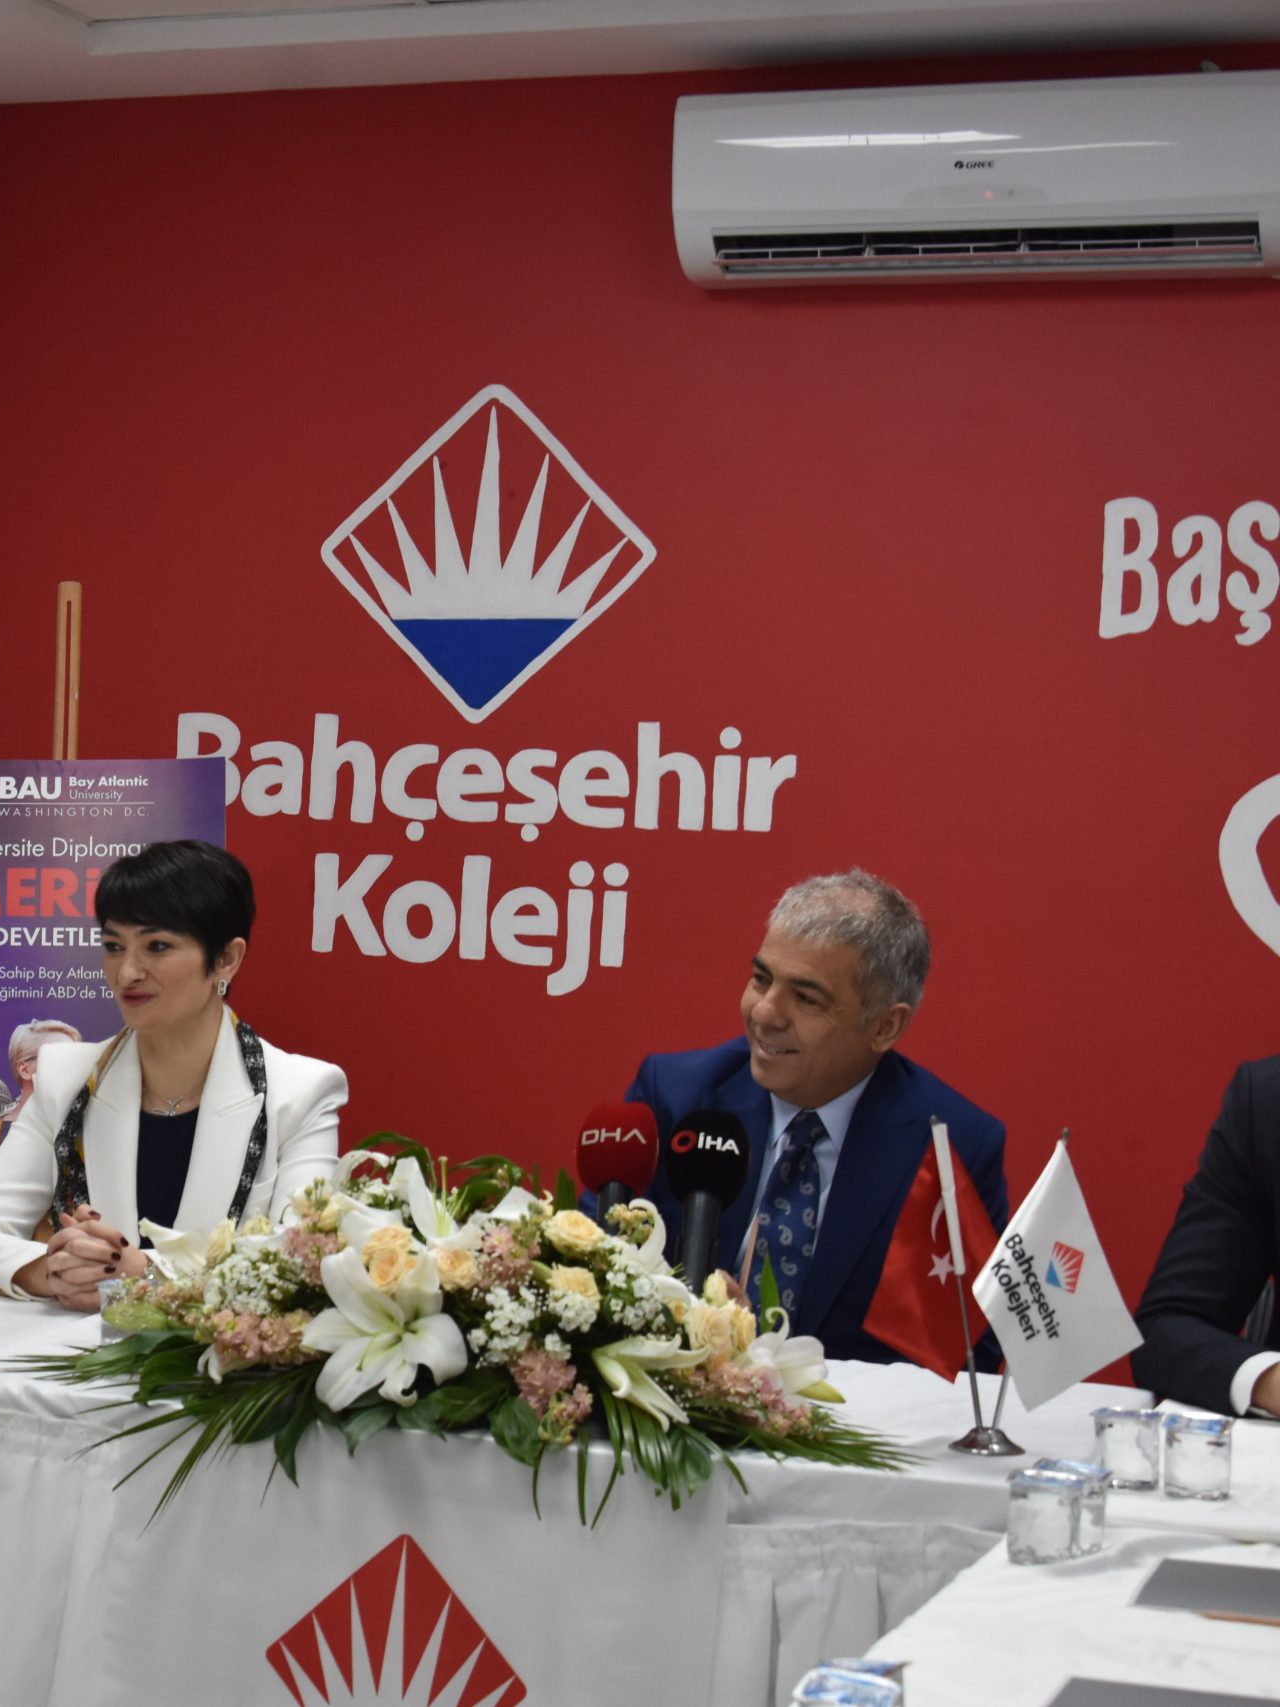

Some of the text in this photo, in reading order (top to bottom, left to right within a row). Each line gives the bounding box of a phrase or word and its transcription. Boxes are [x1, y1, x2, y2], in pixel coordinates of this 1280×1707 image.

[1098, 496, 1280, 646] Baş
[0, 776, 62, 800] BAU
[69, 775, 149, 791] Bay Atlantic
[176, 712, 797, 842] Bahçeşehir
[69, 789, 123, 802] University
[124, 807, 150, 817] D.C.
[52, 835, 147, 863] Diploma
[311, 852, 630, 997] Koleji
[38, 968, 62, 981] Bay
[66, 965, 106, 980] Atlant
[581, 1127, 646, 1146] DHA
[991, 1258, 1041, 1341] Kolejleri
[1004, 1233, 1060, 1340] Bahçeşehir
